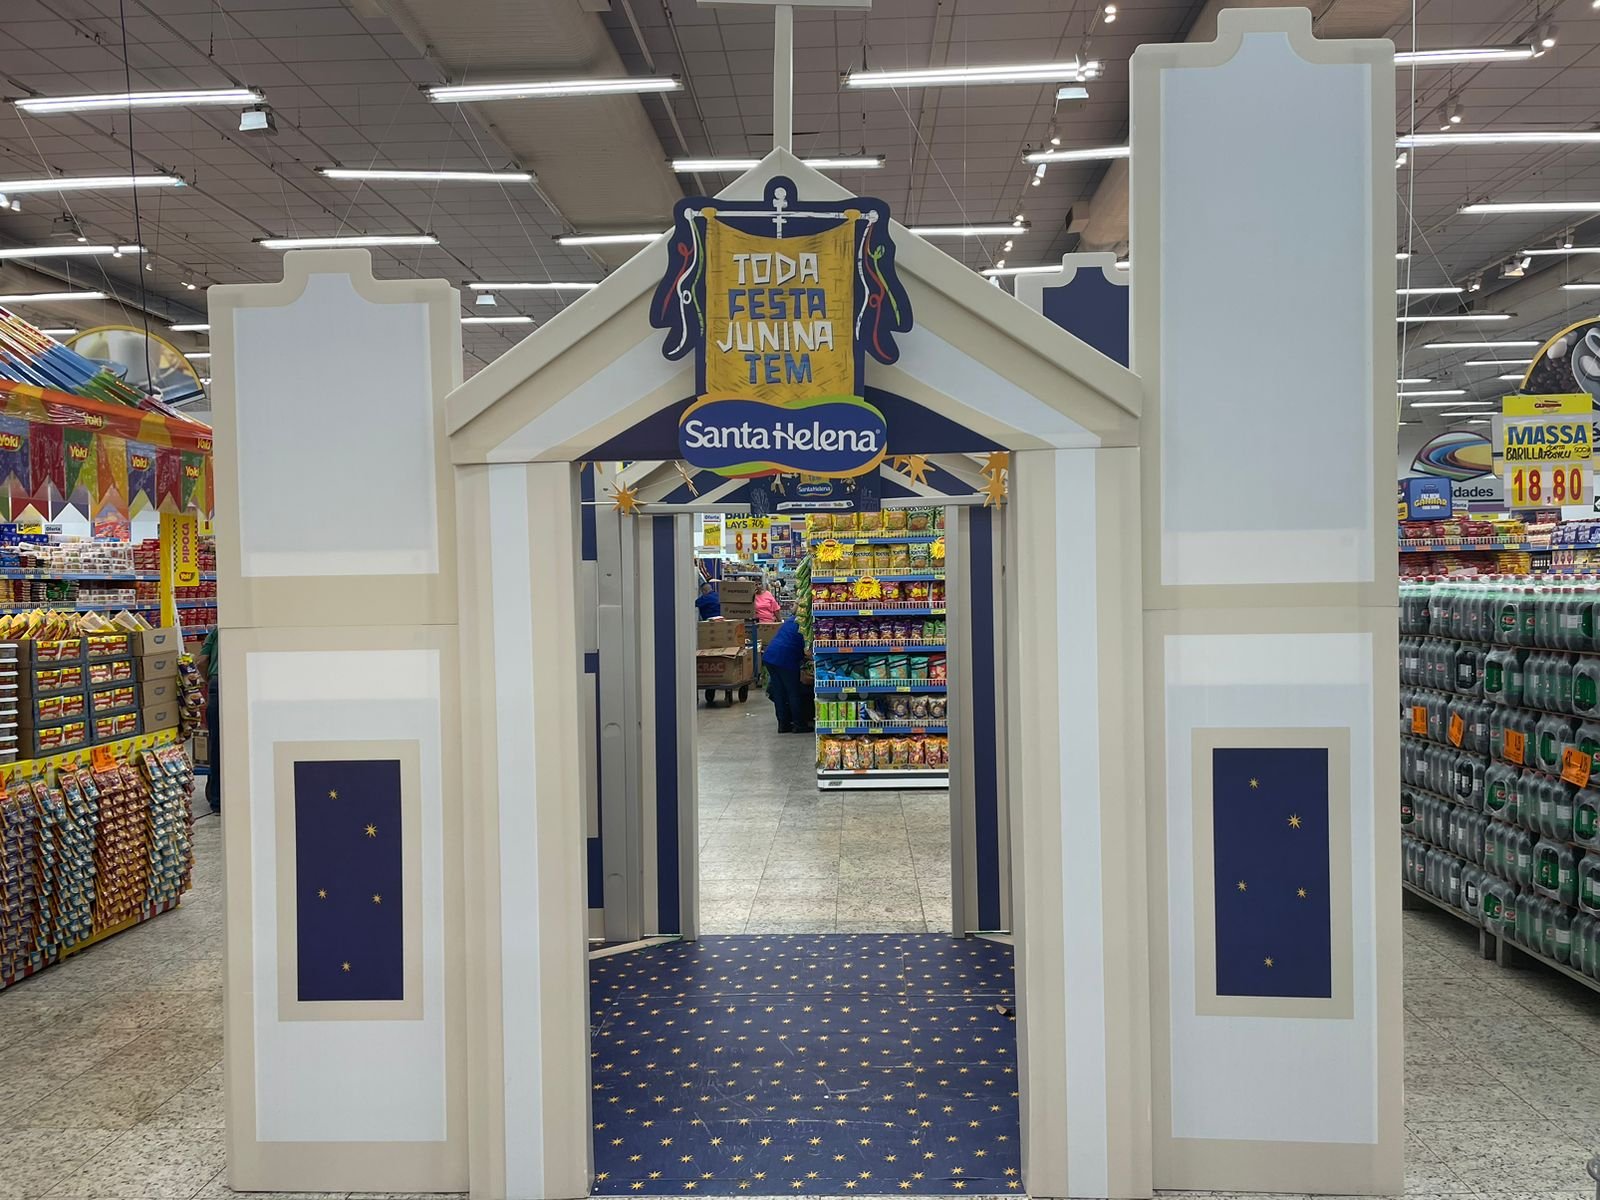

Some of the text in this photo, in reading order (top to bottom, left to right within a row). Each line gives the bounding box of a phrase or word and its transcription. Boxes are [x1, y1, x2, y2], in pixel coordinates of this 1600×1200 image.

[733, 253, 819, 285] TODA
[728, 288, 826, 320] FESTA
[717, 321, 833, 352] JUNINA
[745, 353, 812, 384] TEM
[1507, 424, 1587, 445] MASSA
[69, 445, 88, 458] Yoki
[131, 456, 148, 468] Yoki
[1506, 447, 1544, 460] BARILLA
[1514, 468, 1581, 503] 18,80
[182, 523, 190, 563] PIPOCA
